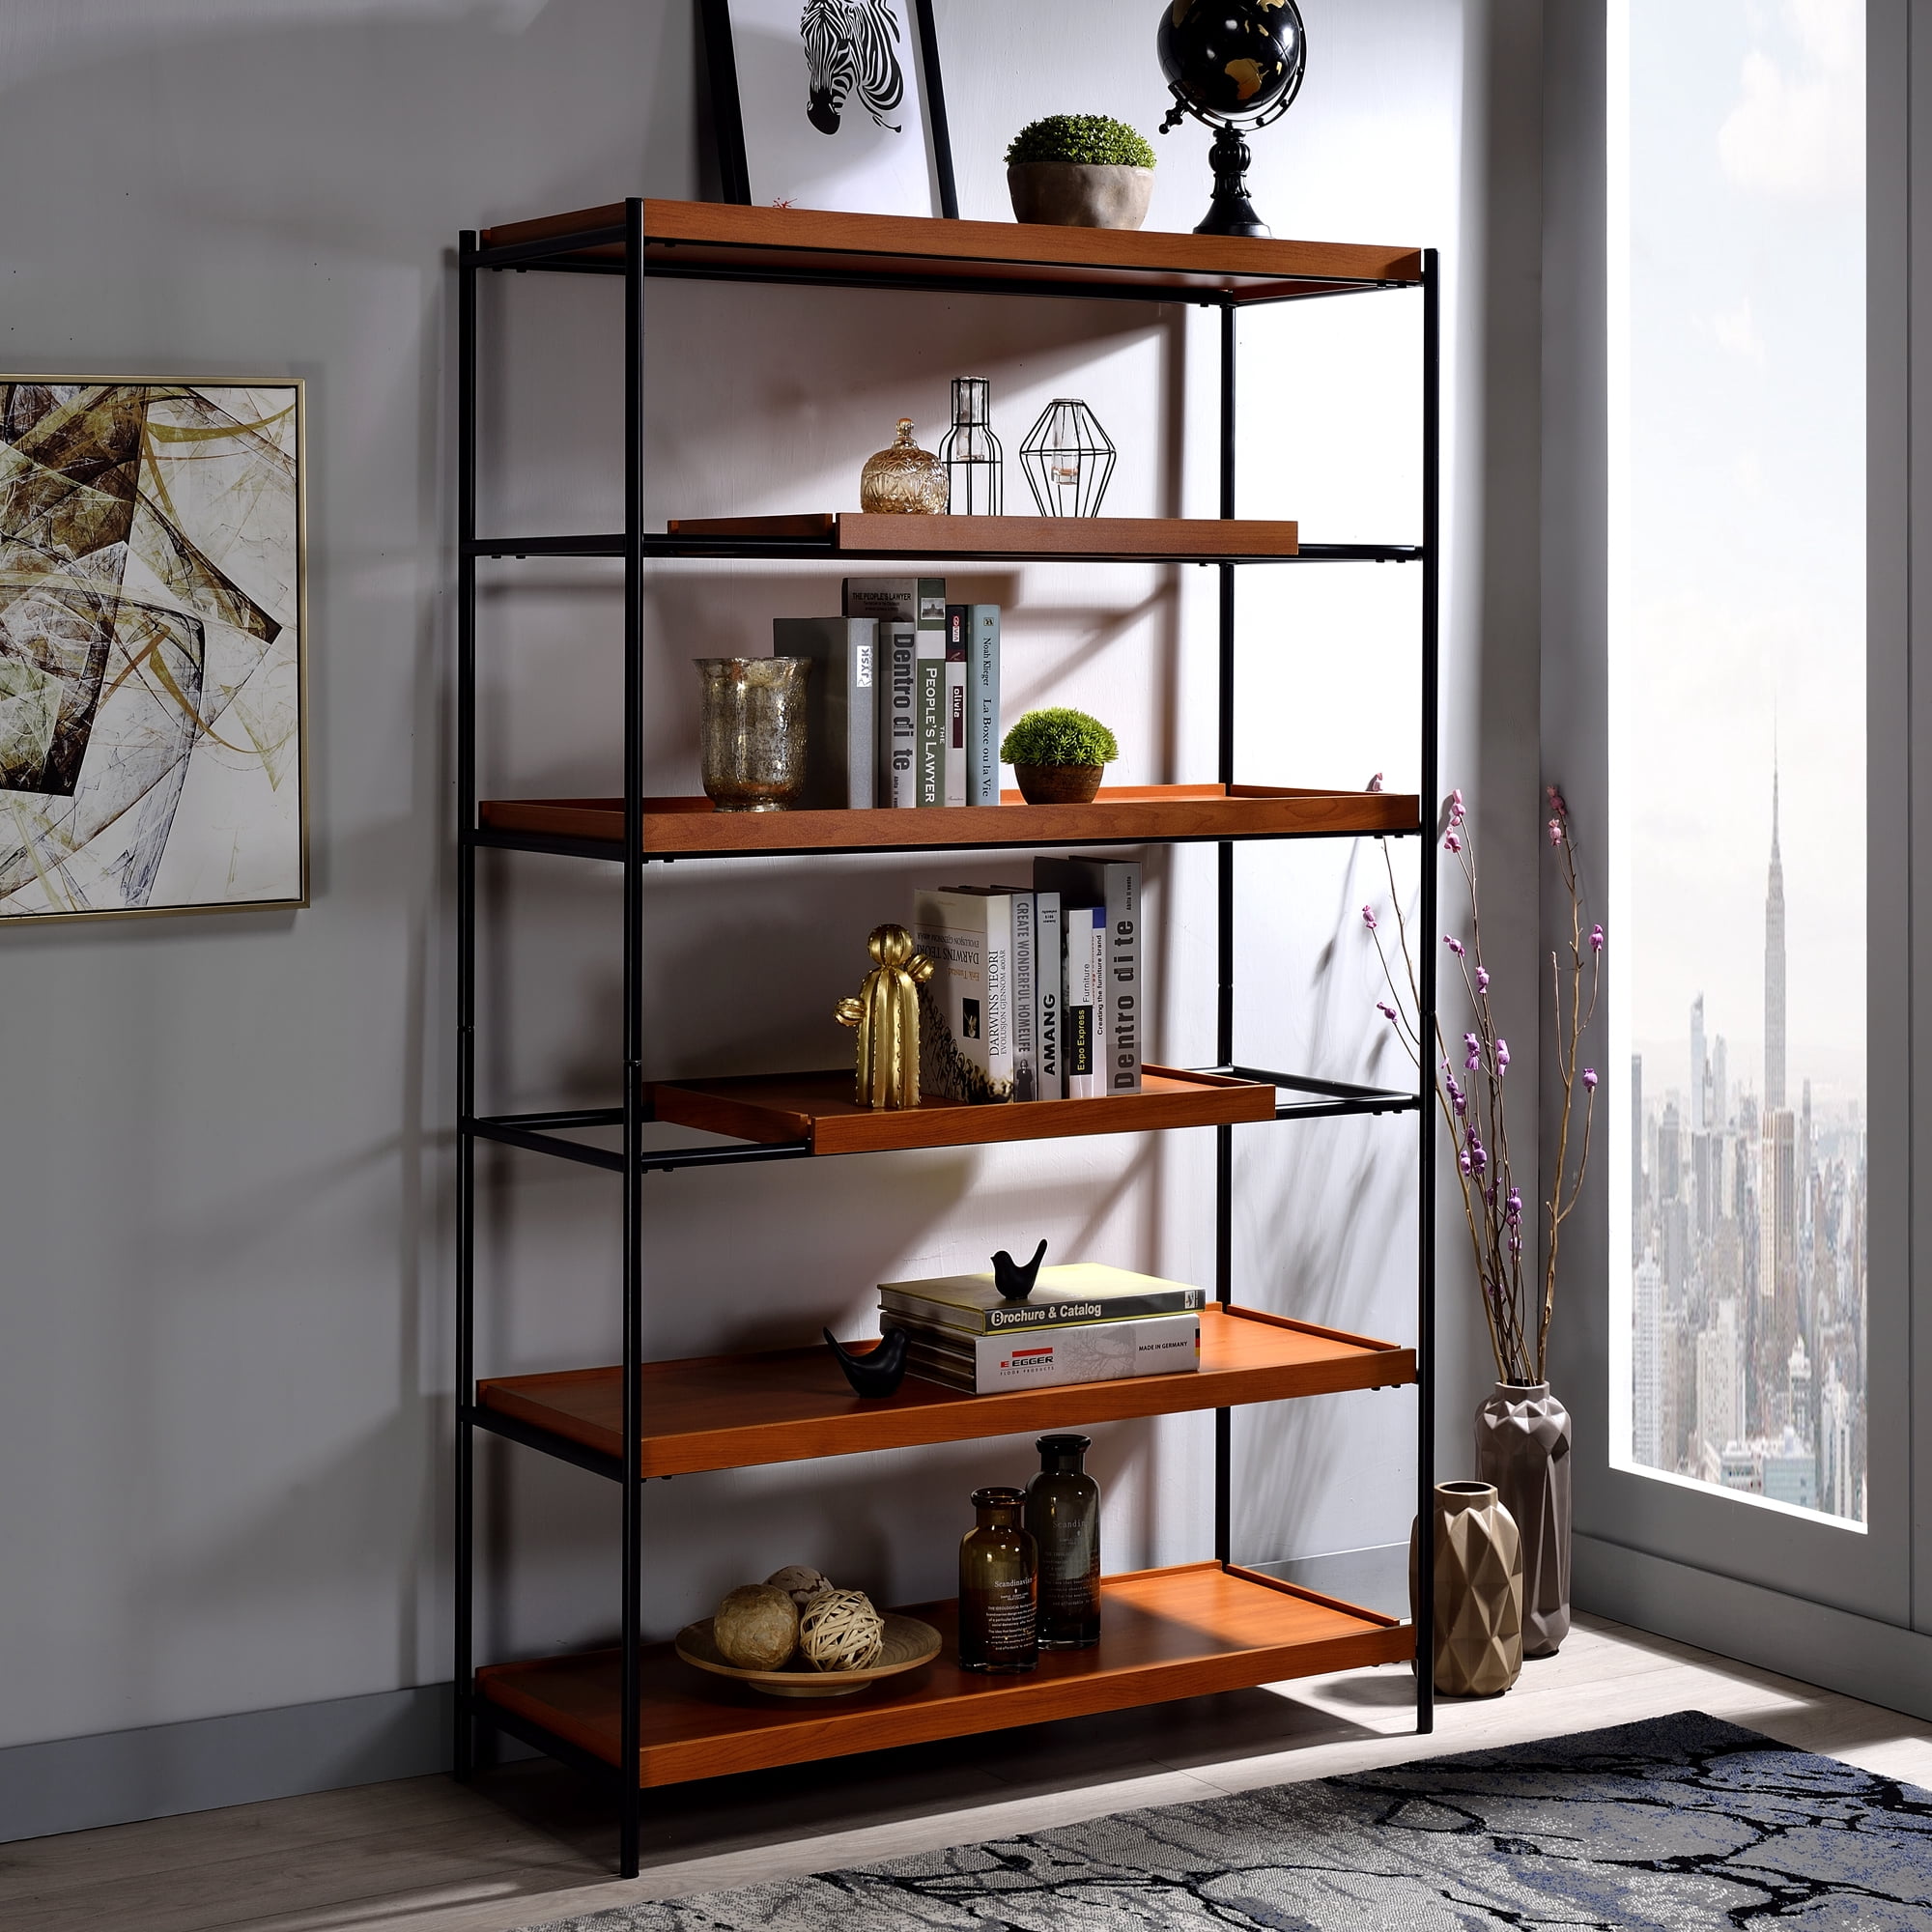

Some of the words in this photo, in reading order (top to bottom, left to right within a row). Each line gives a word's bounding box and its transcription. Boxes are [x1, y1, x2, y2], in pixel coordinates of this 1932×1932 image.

[889, 592, 912, 601] LAWYER
[982, 638, 991, 659] Noah
[861, 648, 870, 678] JYSK
[893, 633, 915, 709] Dentro
[981, 661, 991, 687] Klieger
[925, 668, 938, 738] PEOPLE'S
[953, 688, 964, 718] olivia
[982, 698, 992, 713] La
[893, 716, 915, 737] di
[982, 717, 992, 745] Boxe
[893, 749, 914, 771] te
[981, 749, 989, 762] ou
[924, 742, 937, 803] LAWYER
[981, 765, 991, 776] la
[981, 778, 992, 797] Vie
[1017, 902, 1030, 937] CREATE
[1115, 921, 1134, 947] te
[943, 948, 980, 964] DARWINS
[1113, 955, 1134, 982] di
[988, 951, 999, 991] TEORI
[1017, 940, 1031, 1001] WONDERFUL
[988, 994, 1000, 1057] DARWINS
[1018, 1005, 1031, 1053] HOMELIFE
[1043, 993, 1056, 1076] AMANG
[1077, 1009, 1087, 1046] Express
[1114, 995, 1135, 1089] Dentro
[1077, 1048, 1087, 1071] Expo
[991, 1310, 1045, 1326] Brochure
[1048, 1306, 1057, 1319] &
[1060, 1303, 1102, 1317] Catalog
[1161, 1341, 1188, 1350] GERMANY
[1011, 1355, 1054, 1367] EGGER
